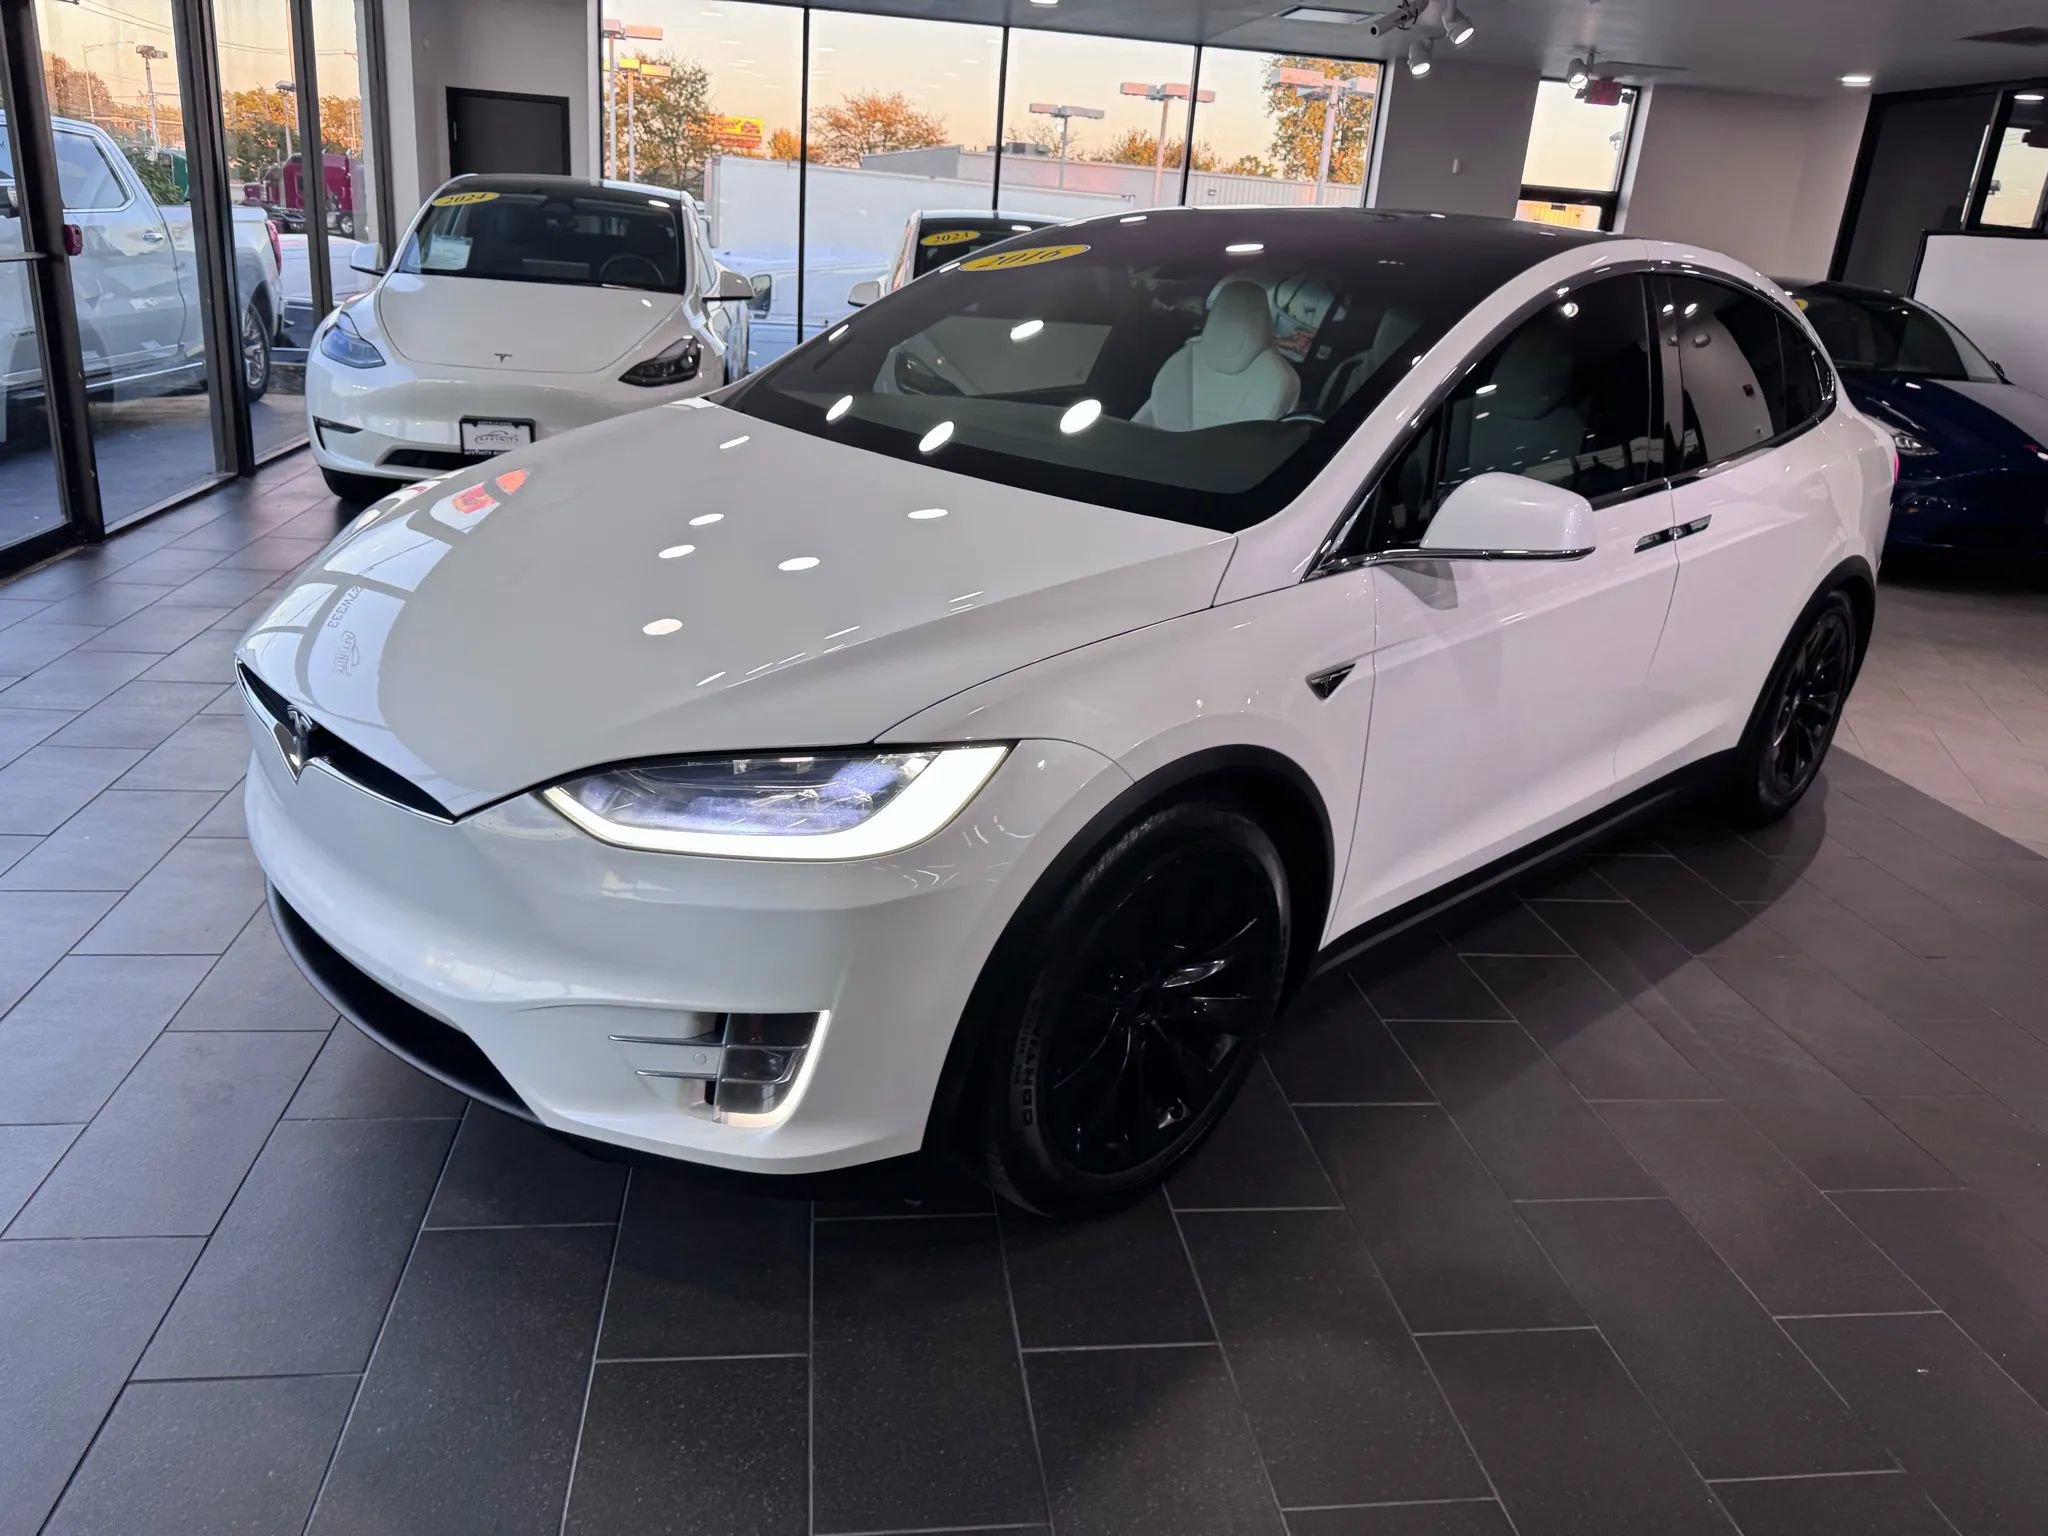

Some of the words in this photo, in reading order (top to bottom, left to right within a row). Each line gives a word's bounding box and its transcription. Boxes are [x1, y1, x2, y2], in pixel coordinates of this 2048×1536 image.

[445, 193, 487, 204] 2024
[976, 248, 1063, 268] 2016
[327, 585, 362, 628] 27W333
